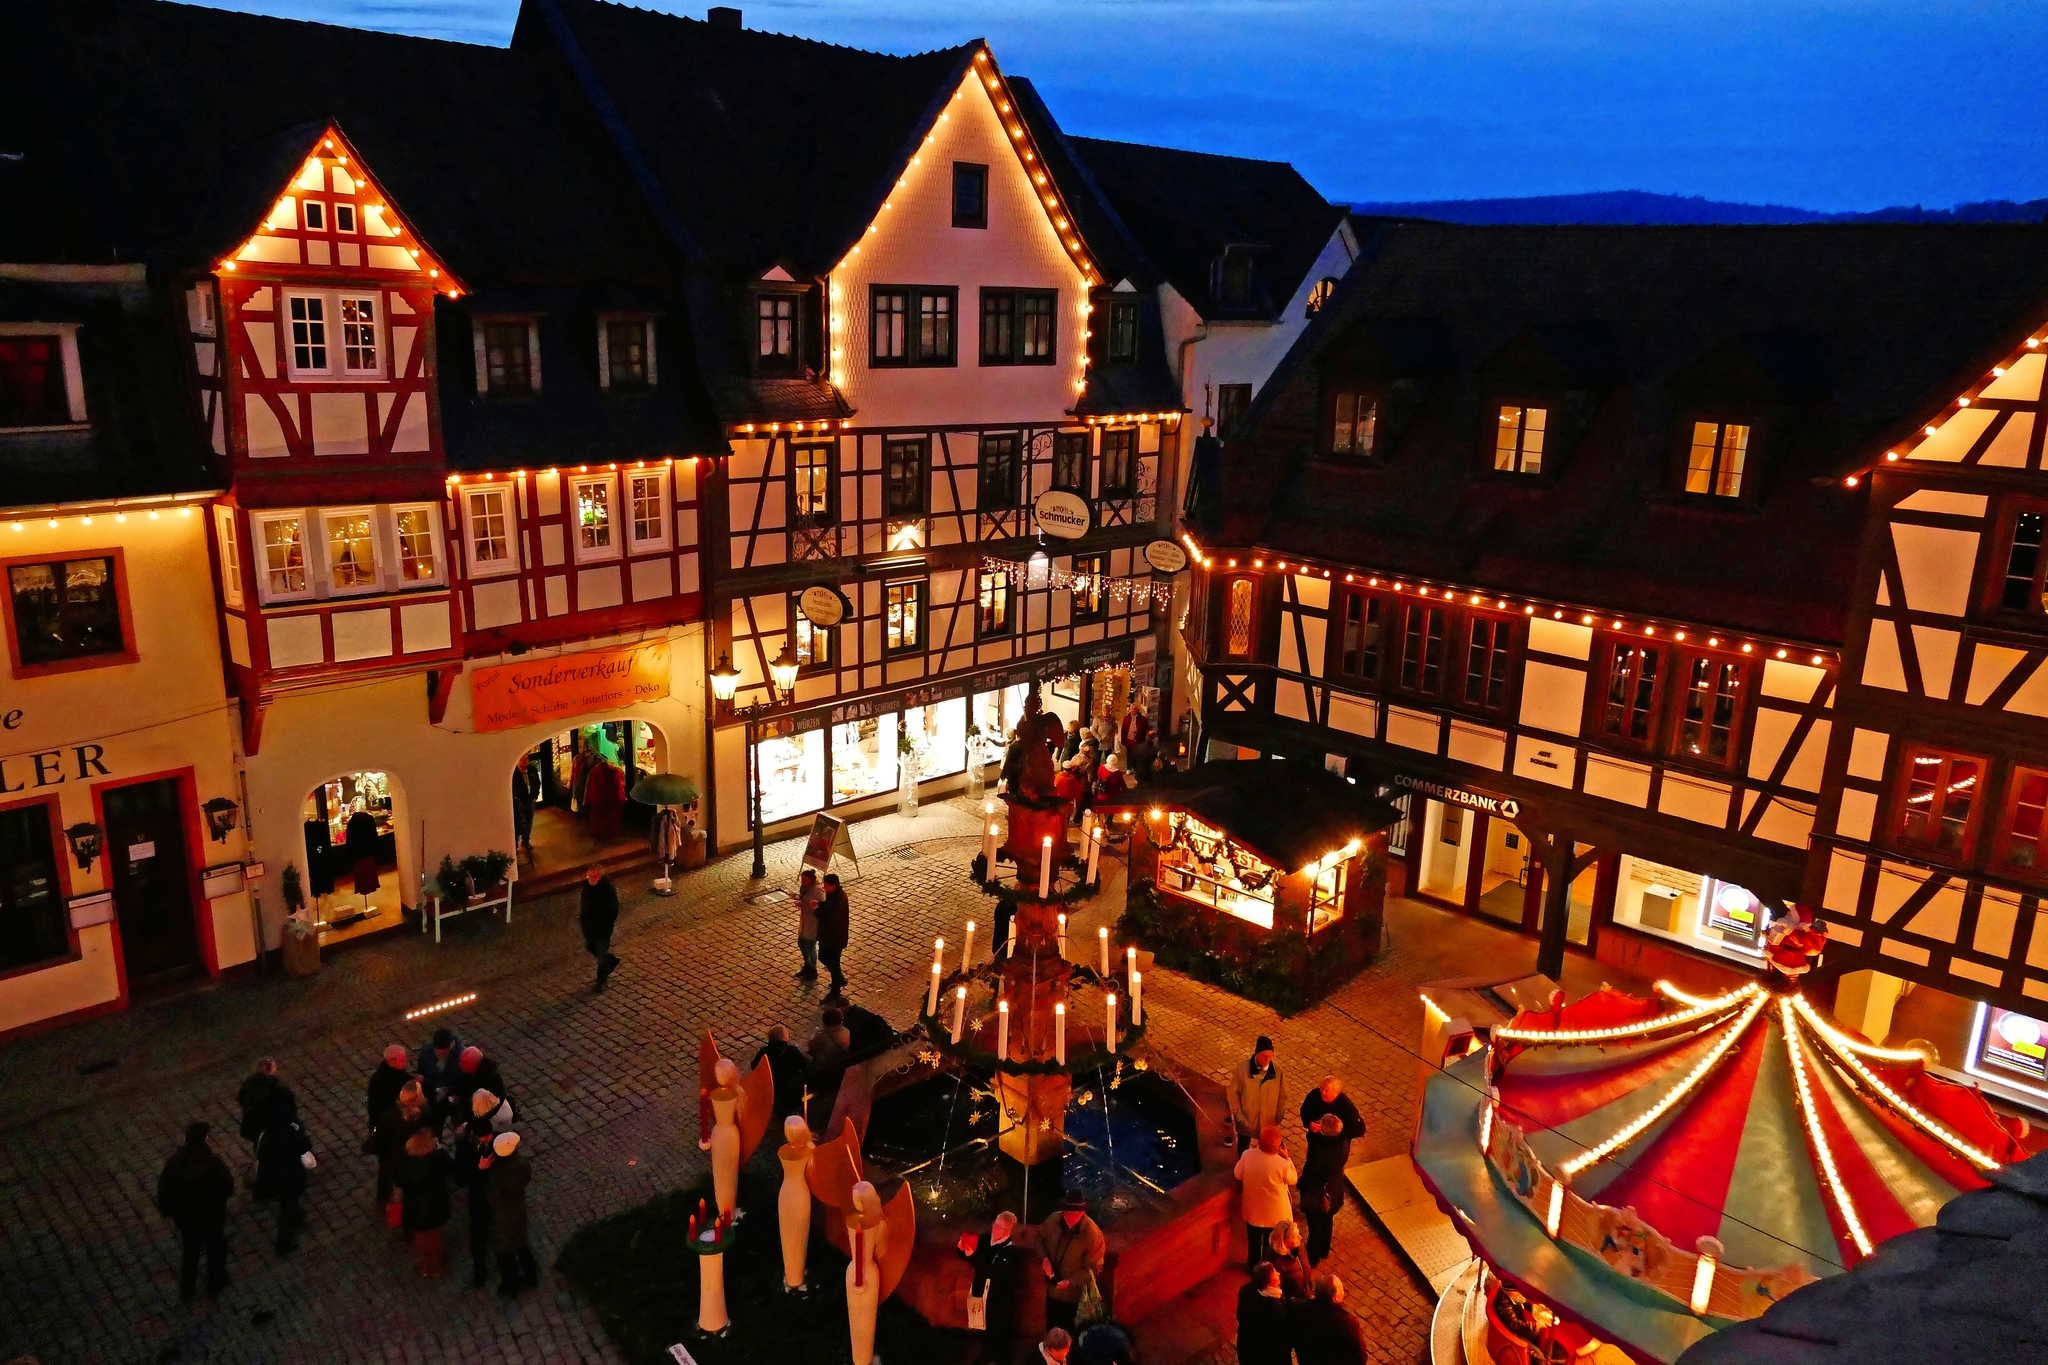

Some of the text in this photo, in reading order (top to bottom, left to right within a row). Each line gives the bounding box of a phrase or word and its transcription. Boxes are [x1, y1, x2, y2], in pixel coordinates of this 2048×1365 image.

[475, 669, 501, 692] Portal
[508, 655, 634, 693] Sonderverkauf
[486, 681, 660, 725] Mode Schuhe Interiors Deko
[1393, 774, 1498, 813] COMMERZBANK
